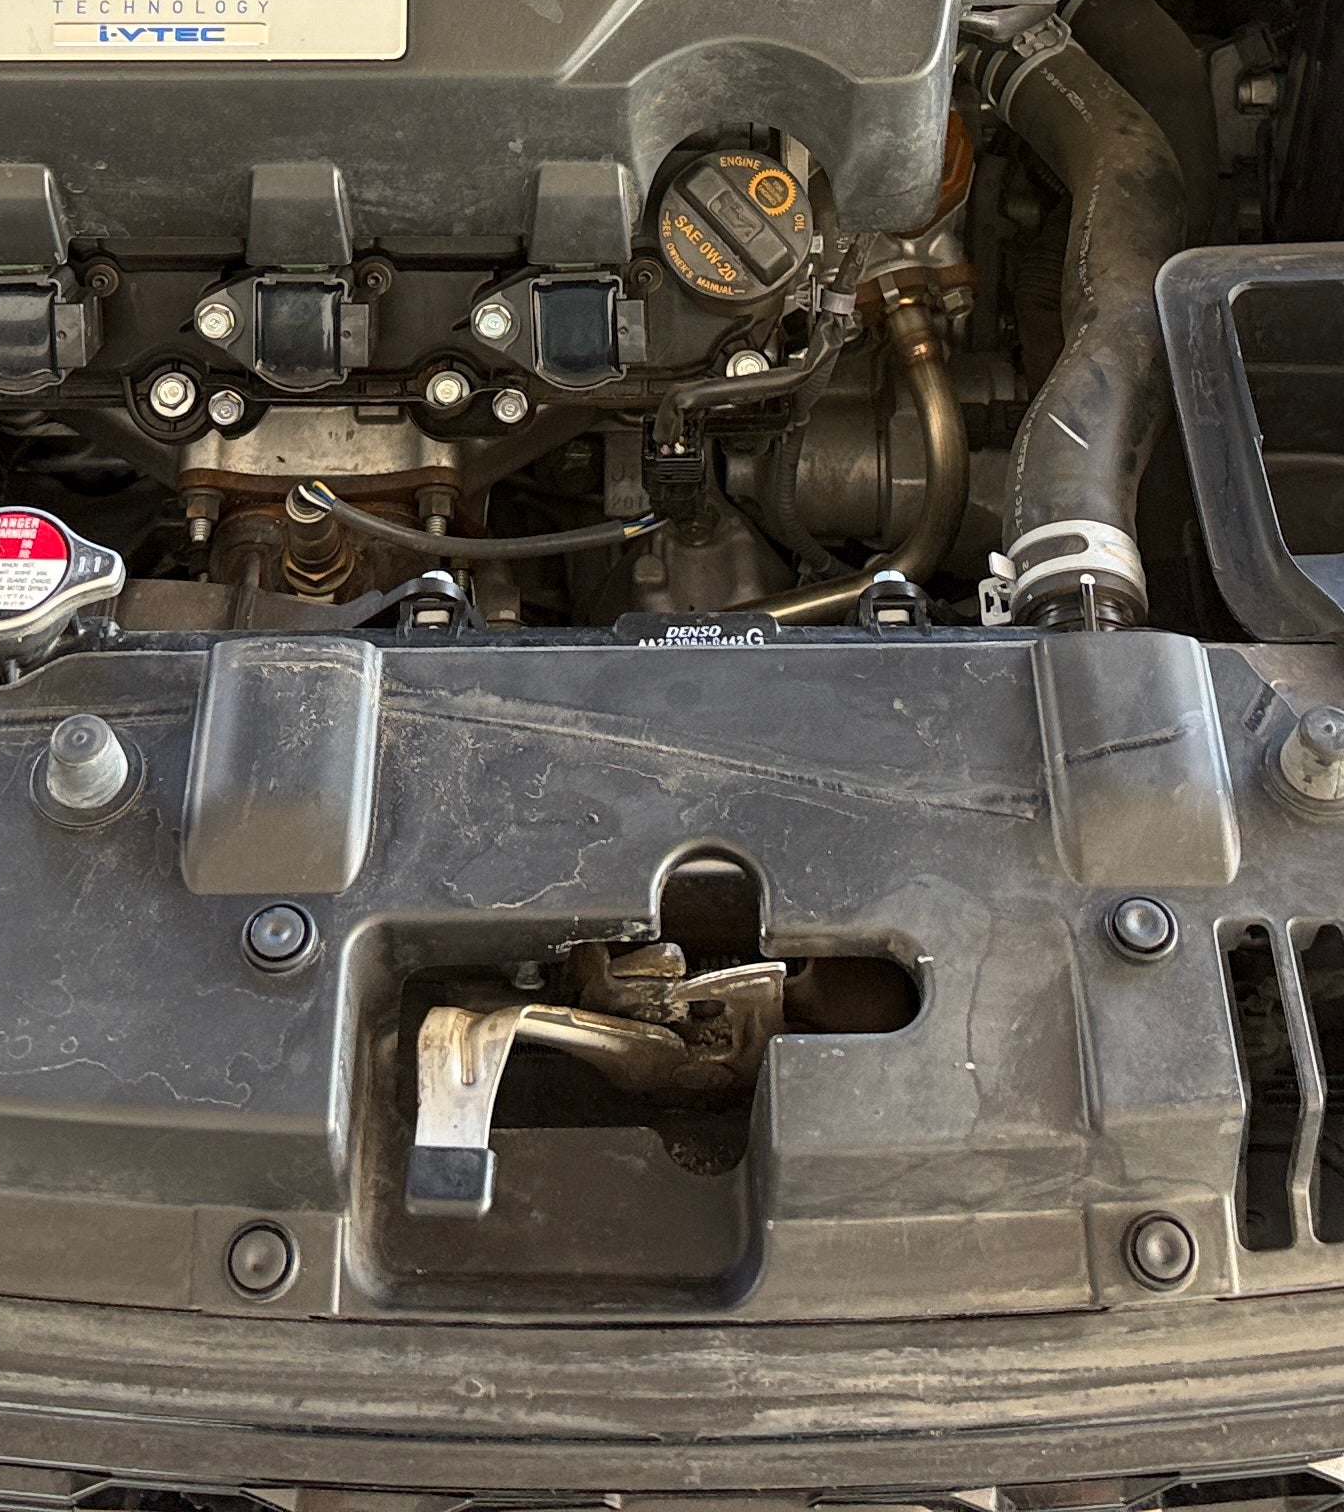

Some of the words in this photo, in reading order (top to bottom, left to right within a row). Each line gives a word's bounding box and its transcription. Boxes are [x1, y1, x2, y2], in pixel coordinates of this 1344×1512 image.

[52, 0, 271, 15] TECHNOLOGY
[99, 24, 226, 43] i-VTEC
[720, 156, 762, 170] ENGINE
[794, 214, 806, 232] OIL
[674, 214, 704, 245] SAE
[699, 241, 737, 282] 0W-20
[666, 242, 695, 279] OWNER'S
[666, 625, 721, 637] DENSO
[746, 628, 764, 646] G
